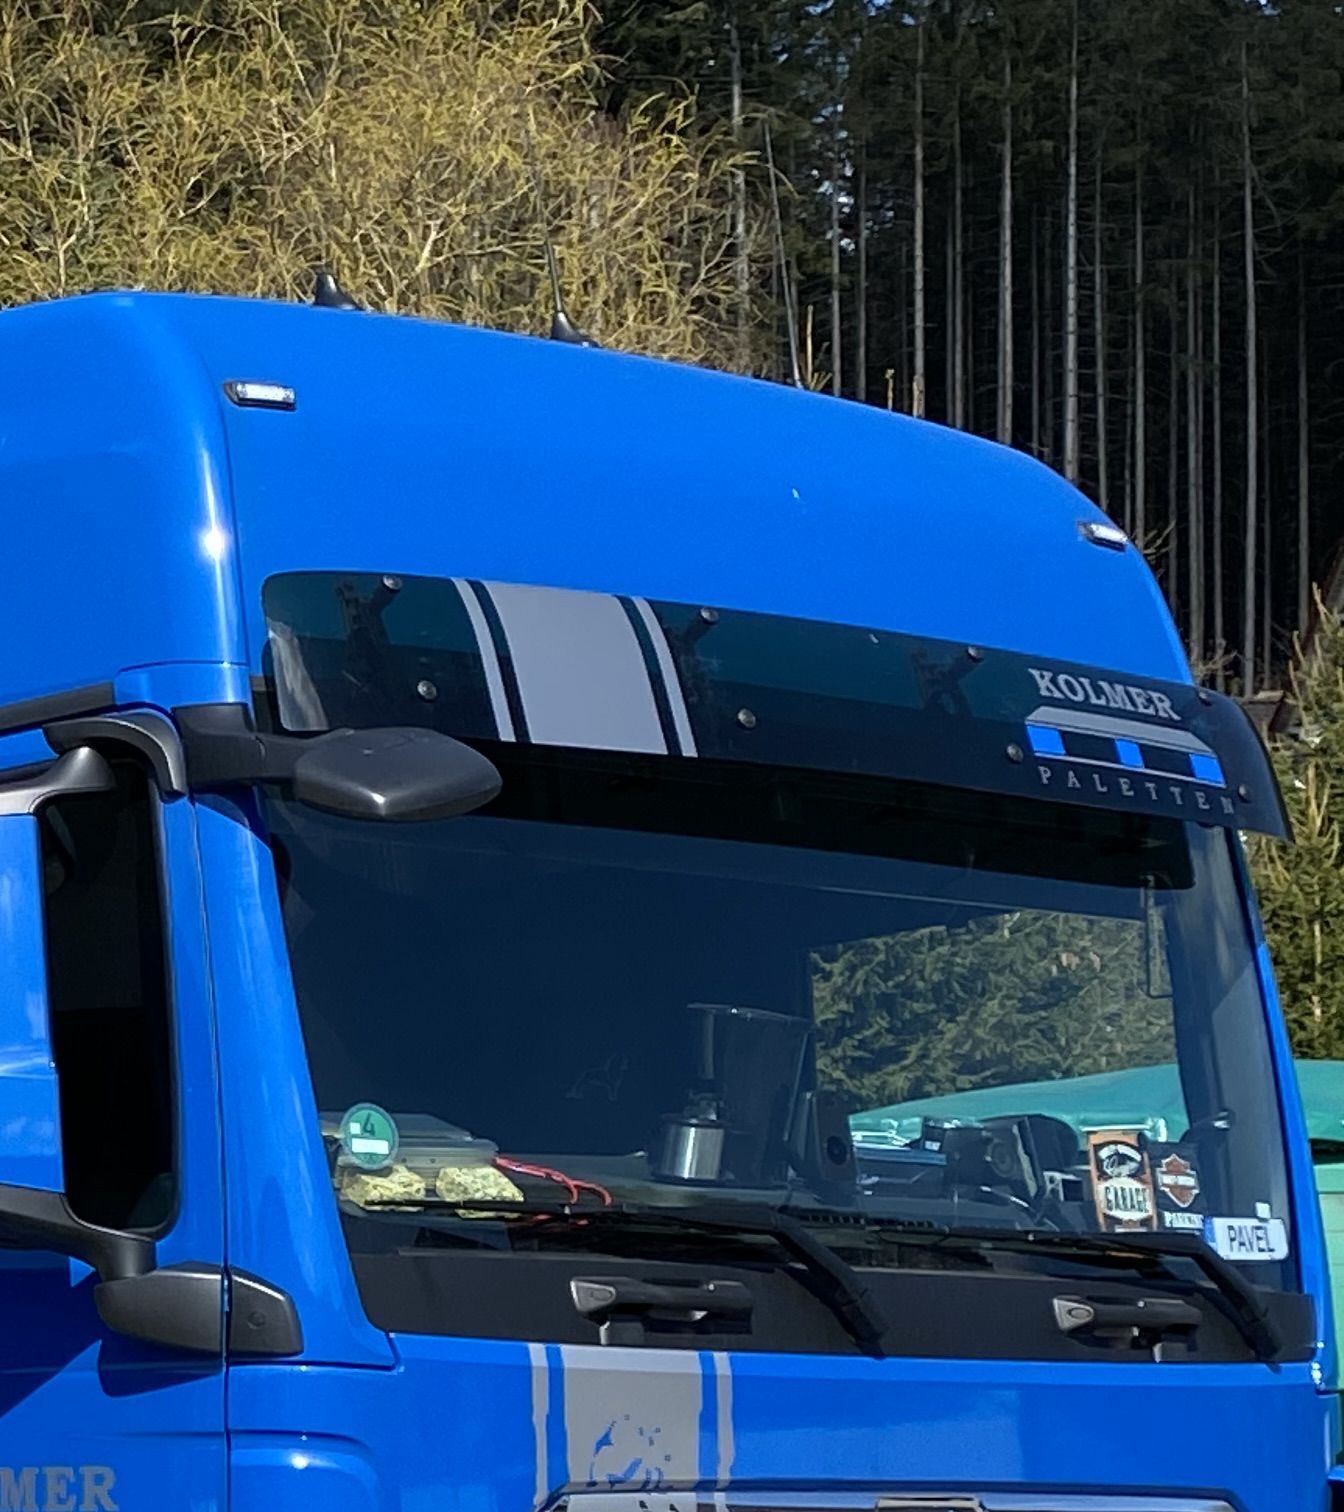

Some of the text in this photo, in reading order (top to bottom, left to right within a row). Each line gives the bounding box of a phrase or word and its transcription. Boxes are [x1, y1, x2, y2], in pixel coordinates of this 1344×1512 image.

[1028, 668, 1181, 720] KOLMER
[1038, 766, 1234, 814] PALETTEN
[362, 1112, 376, 1137] 4
[1227, 1225, 1276, 1252] PAVEL
